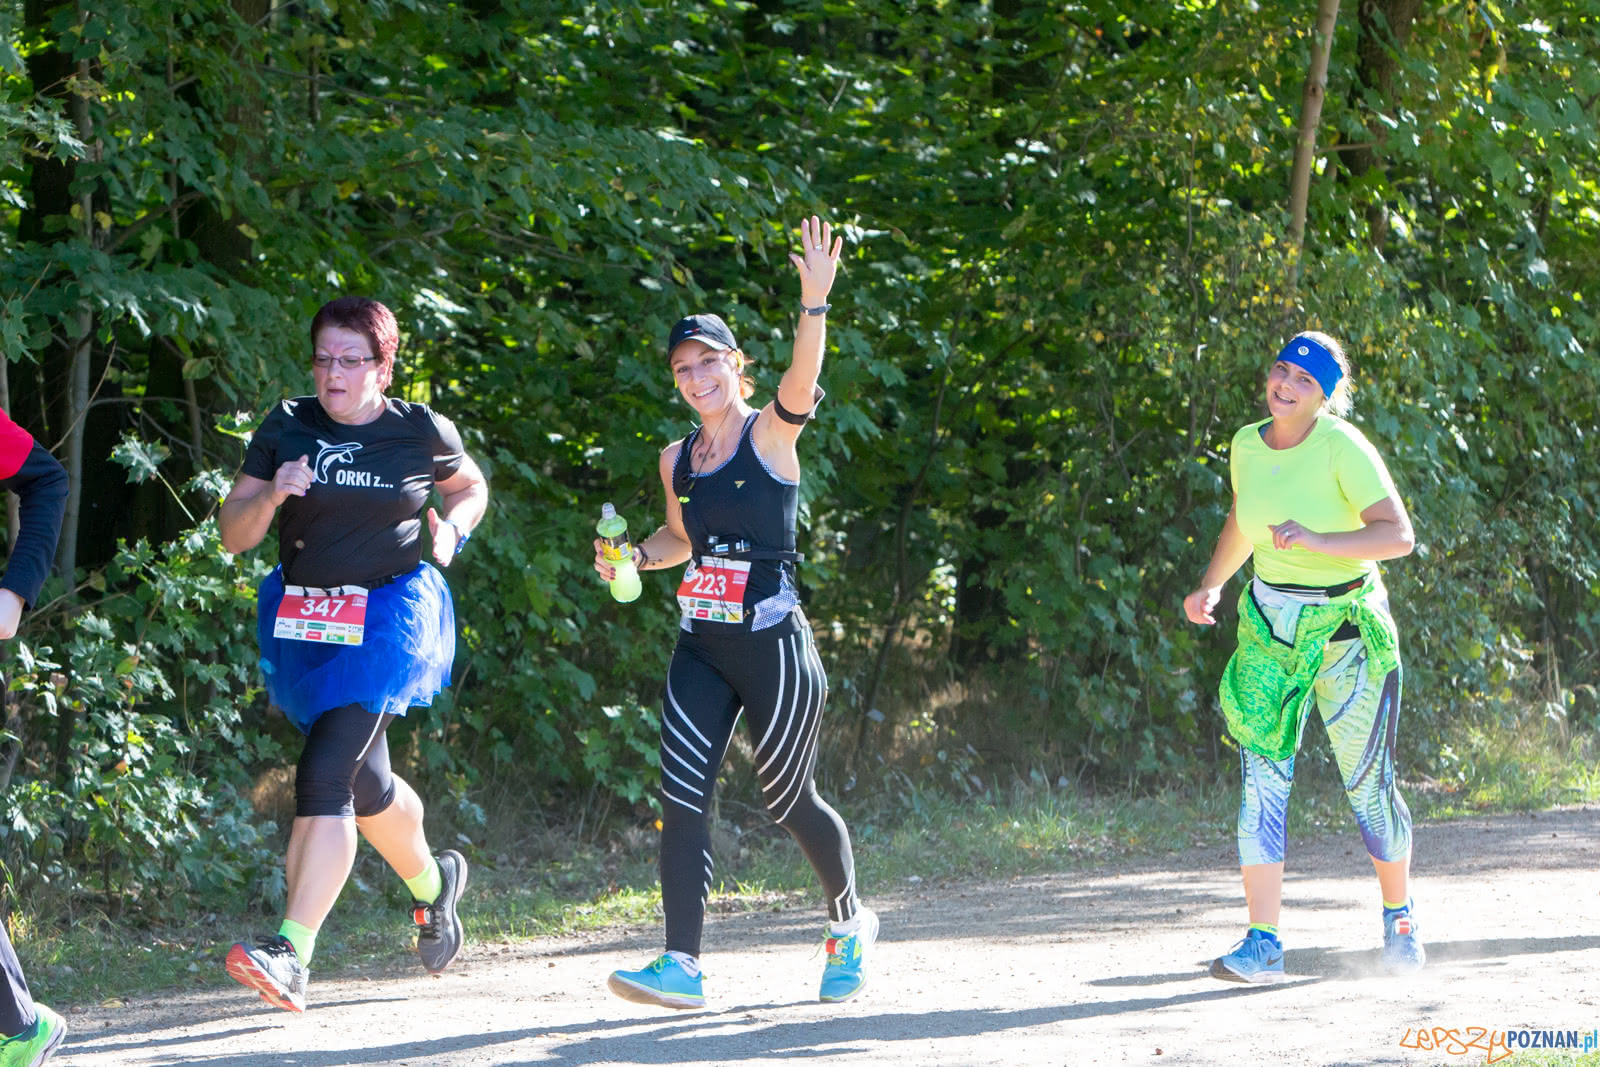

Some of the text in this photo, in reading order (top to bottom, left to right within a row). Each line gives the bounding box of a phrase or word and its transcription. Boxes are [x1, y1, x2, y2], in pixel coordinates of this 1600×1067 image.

[336, 469, 394, 488] ORKI z...
[691, 571, 727, 597] 223
[300, 599, 346, 618] 347
